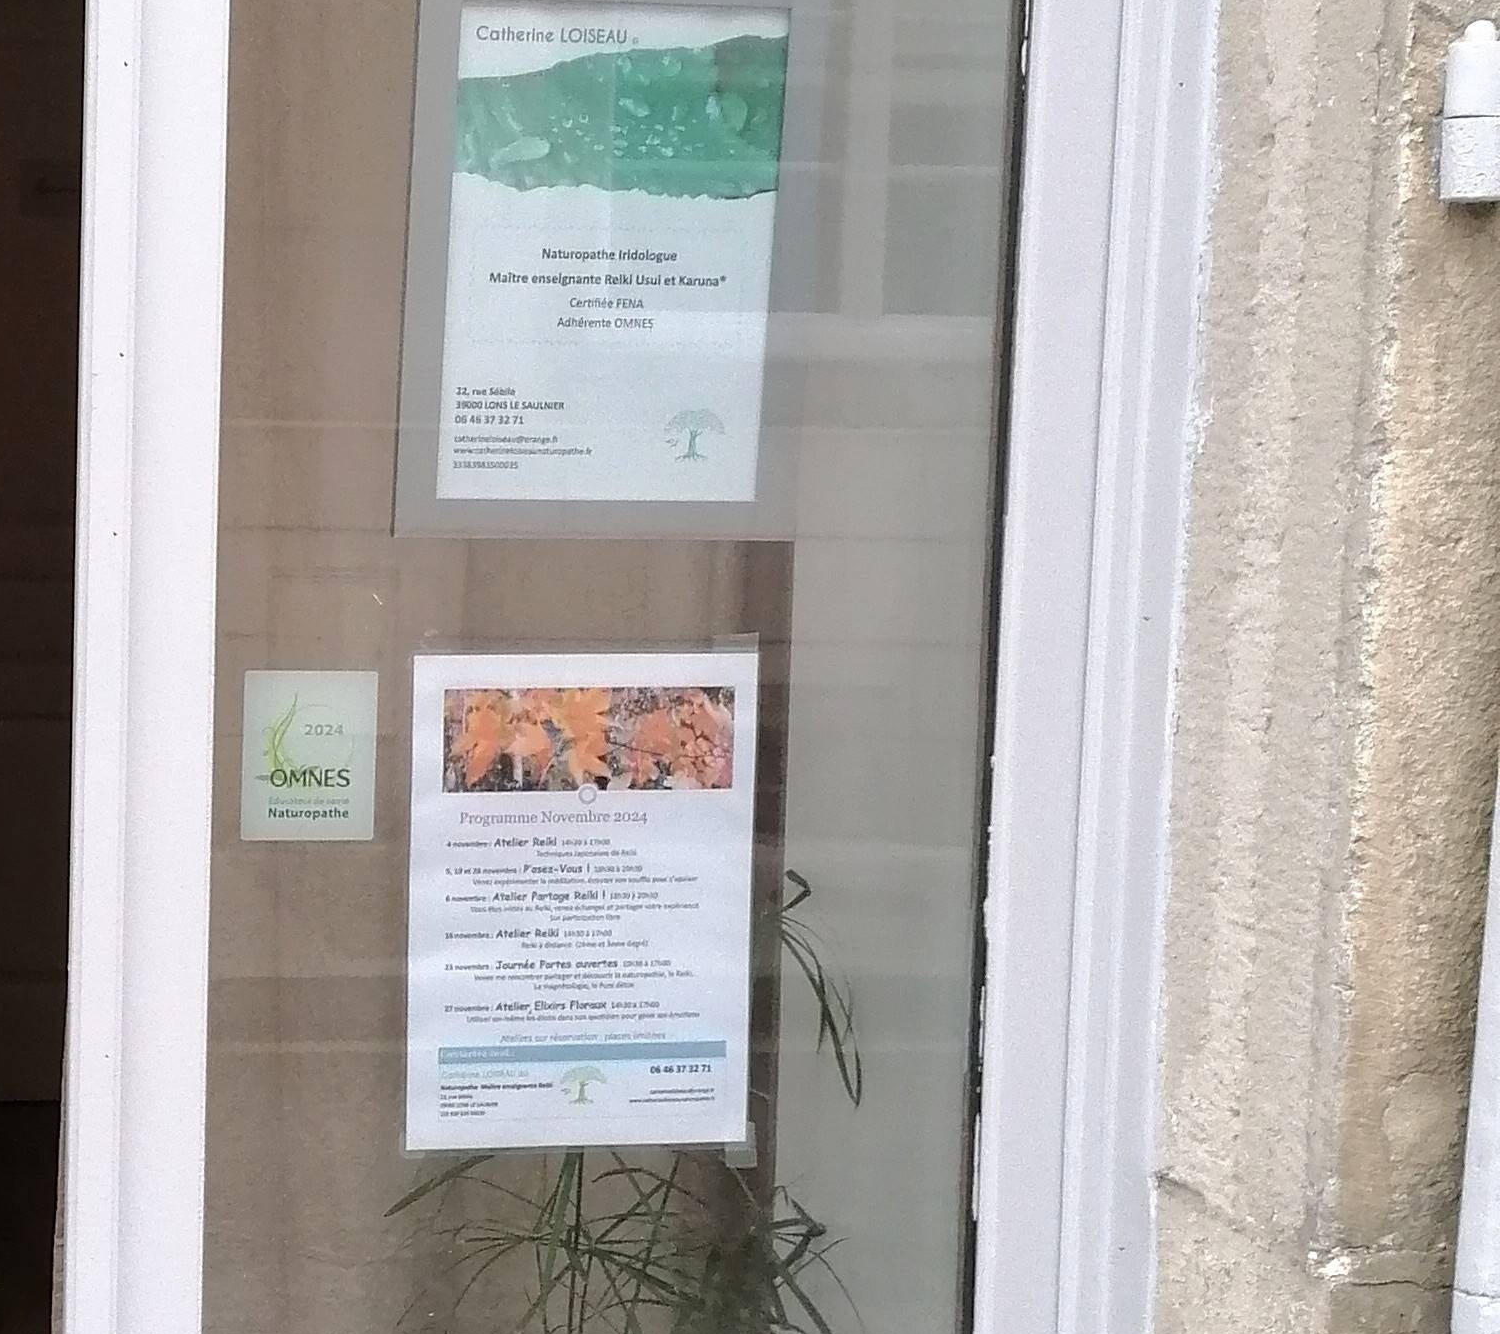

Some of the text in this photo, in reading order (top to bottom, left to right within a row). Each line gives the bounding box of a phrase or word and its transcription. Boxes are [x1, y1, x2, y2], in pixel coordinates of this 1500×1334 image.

[476, 25, 553, 43] Catherine
[560, 27, 628, 44] LOISEAU
[541, 247, 677, 264] Naturopathe Iridologue
[489, 272, 528, 284] Maître
[531, 273, 601, 287] enseignante
[604, 274, 632, 286] Reiki
[635, 274, 661, 286] Usui
[664, 276, 676, 286] et
[569, 296, 644, 309] Certifiée FENA
[557, 317, 654, 329] Adhérente OMNES
[510, 401, 520, 410] LE
[304, 723, 344, 736] 2024
[270, 768, 351, 788] OMNES
[267, 808, 350, 821] Naturopathe
[459, 811, 649, 827] Programme Novembre 2024
[494, 837, 529, 848] Atelier
[532, 836, 557, 847] Reiki
[492, 892, 528, 903] Atelier
[531, 891, 570, 904] Partage
[573, 890, 599, 900] Reiki
[495, 928, 531, 939] Atelier
[534, 928, 560, 938] Reiki
[495, 959, 536, 970] Journée
[539, 959, 572, 969] Portes
[575, 959, 618, 969] ouvertes
